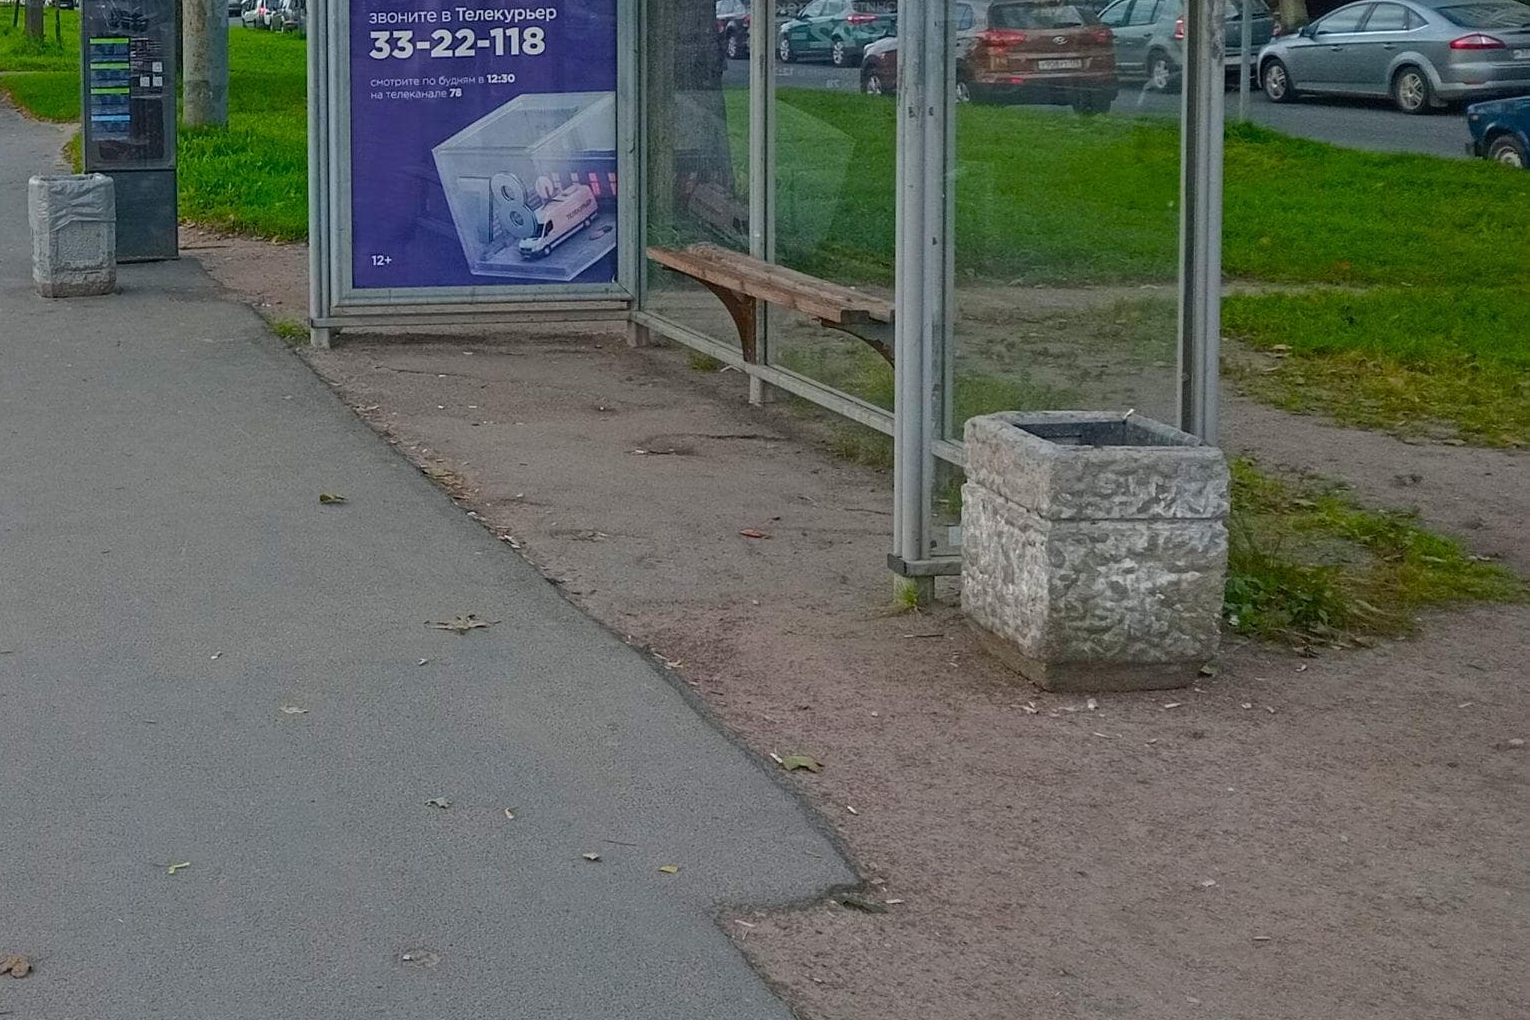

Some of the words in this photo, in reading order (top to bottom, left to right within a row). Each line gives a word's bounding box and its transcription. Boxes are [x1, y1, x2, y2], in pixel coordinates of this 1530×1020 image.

[369, 11, 437, 24] звоните
[441, 11, 451, 22] в
[455, 8, 557, 23] Телекурьер
[369, 26, 546, 60] 33-22-118
[370, 78, 420, 87] смотрите
[422, 77, 436, 85] по
[438, 76, 475, 87] будням
[486, 74, 515, 84] 12:30
[370, 92, 383, 100] на
[386, 89, 447, 100] телеканале
[449, 88, 462, 98] 78
[371, 255, 392, 266] 12+
